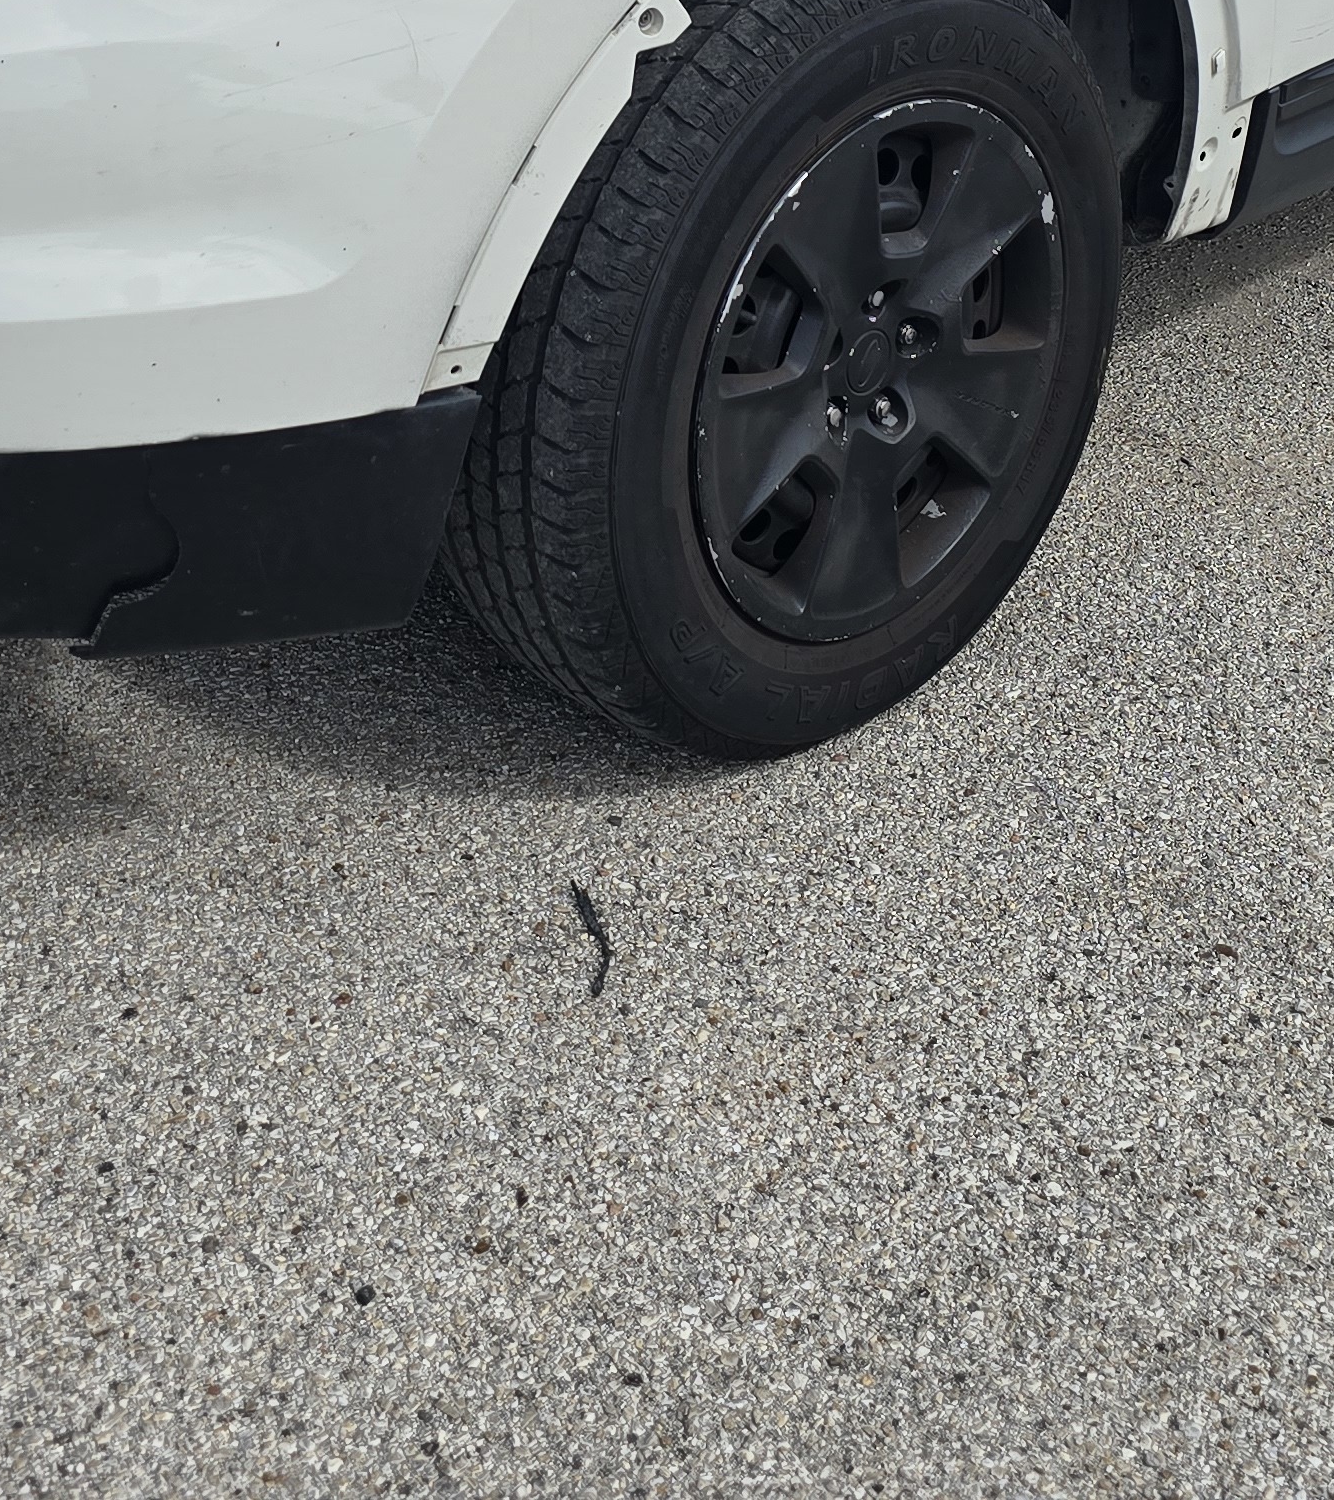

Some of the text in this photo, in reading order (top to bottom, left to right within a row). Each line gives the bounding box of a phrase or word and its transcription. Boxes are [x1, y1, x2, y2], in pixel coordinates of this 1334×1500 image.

[867, 25, 1087, 136] IRONMAN
[669, 613, 958, 724] RADIAL A/P
